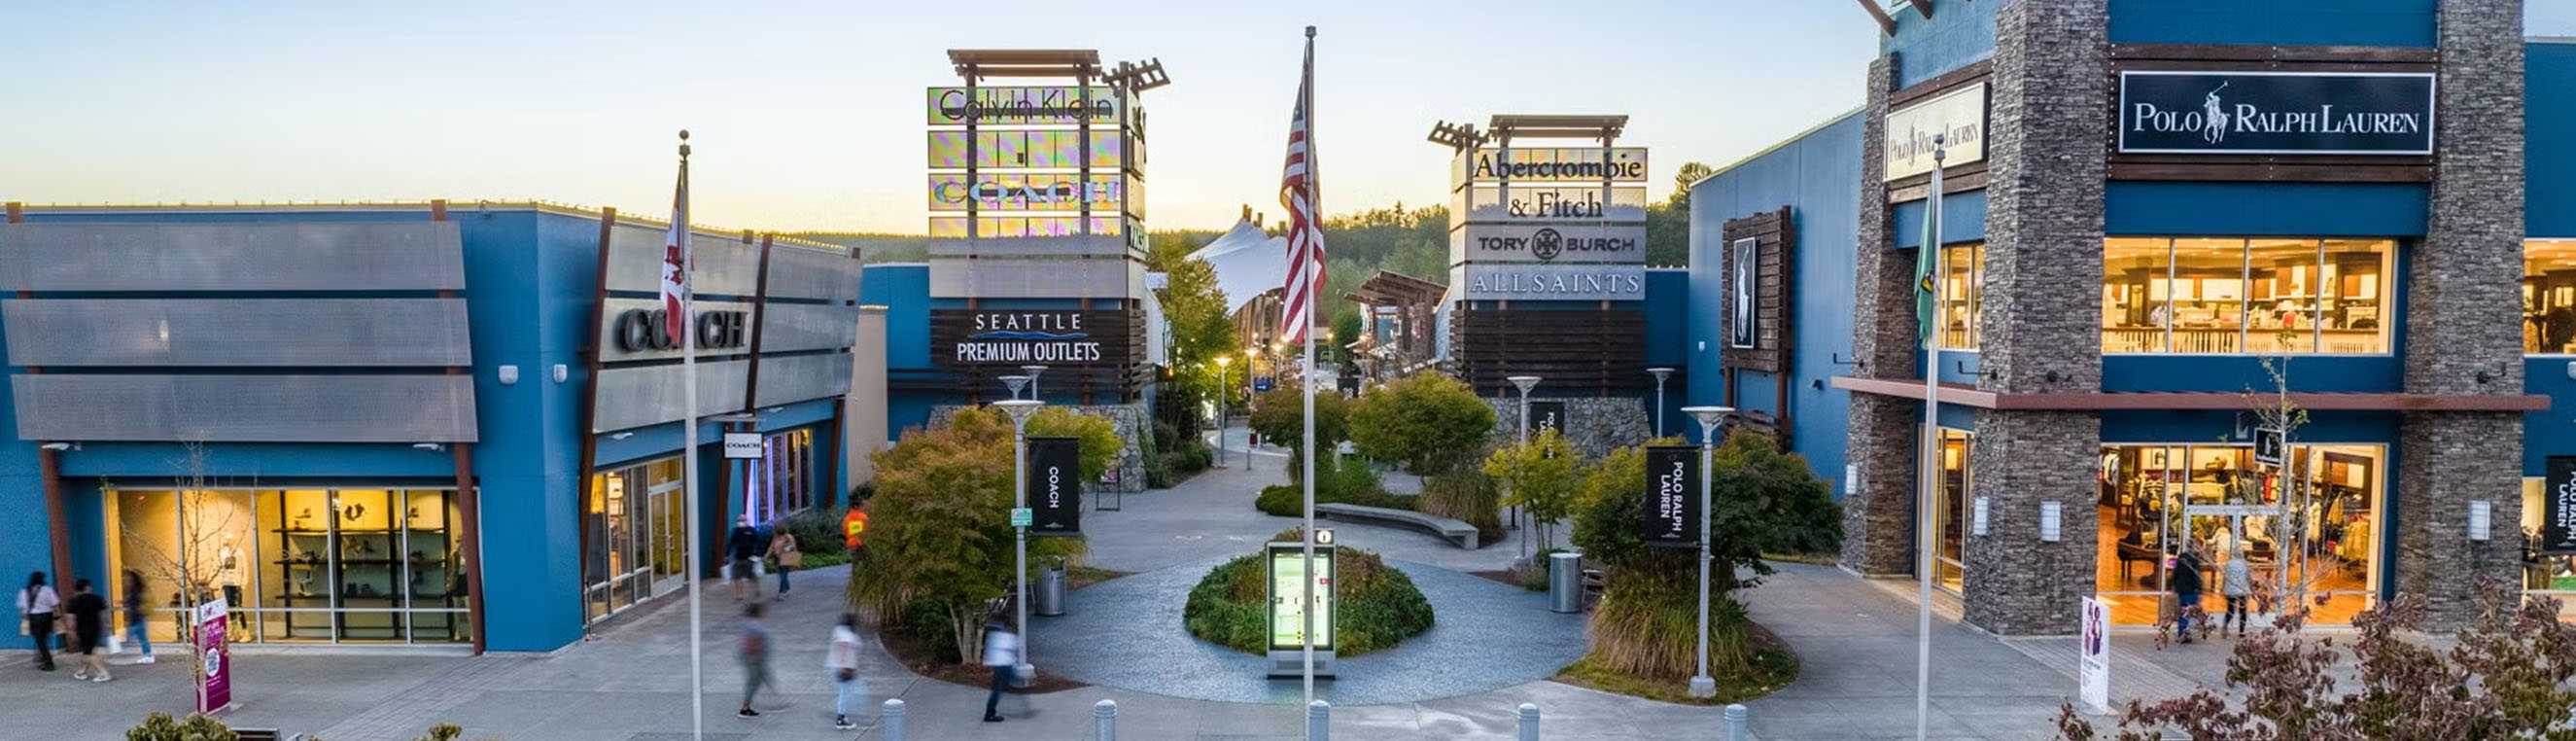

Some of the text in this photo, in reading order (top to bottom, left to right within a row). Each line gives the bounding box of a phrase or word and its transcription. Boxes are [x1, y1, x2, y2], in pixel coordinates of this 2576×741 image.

[940, 89, 1112, 120] Calvin Klein
[2133, 102, 2419, 133] POLO RALPH LAUREN
[1474, 152, 1642, 179] Abercrombie
[934, 181, 1119, 204] COACH
[1510, 191, 1603, 218] & Fitch
[1479, 236, 1635, 252] TORY BURCH
[1473, 273, 1639, 293] ALLSAINTS
[617, 308, 748, 352] COCH
[975, 313, 1082, 331] SEATTLE
[957, 342, 1100, 362] PREMIUM OUTLETS
[1049, 466, 1060, 509] COACH
[1660, 474, 1671, 518] LAUREN
[1672, 461, 1684, 531] POLO RALPH
[2558, 483, 2569, 527] LAUREN
